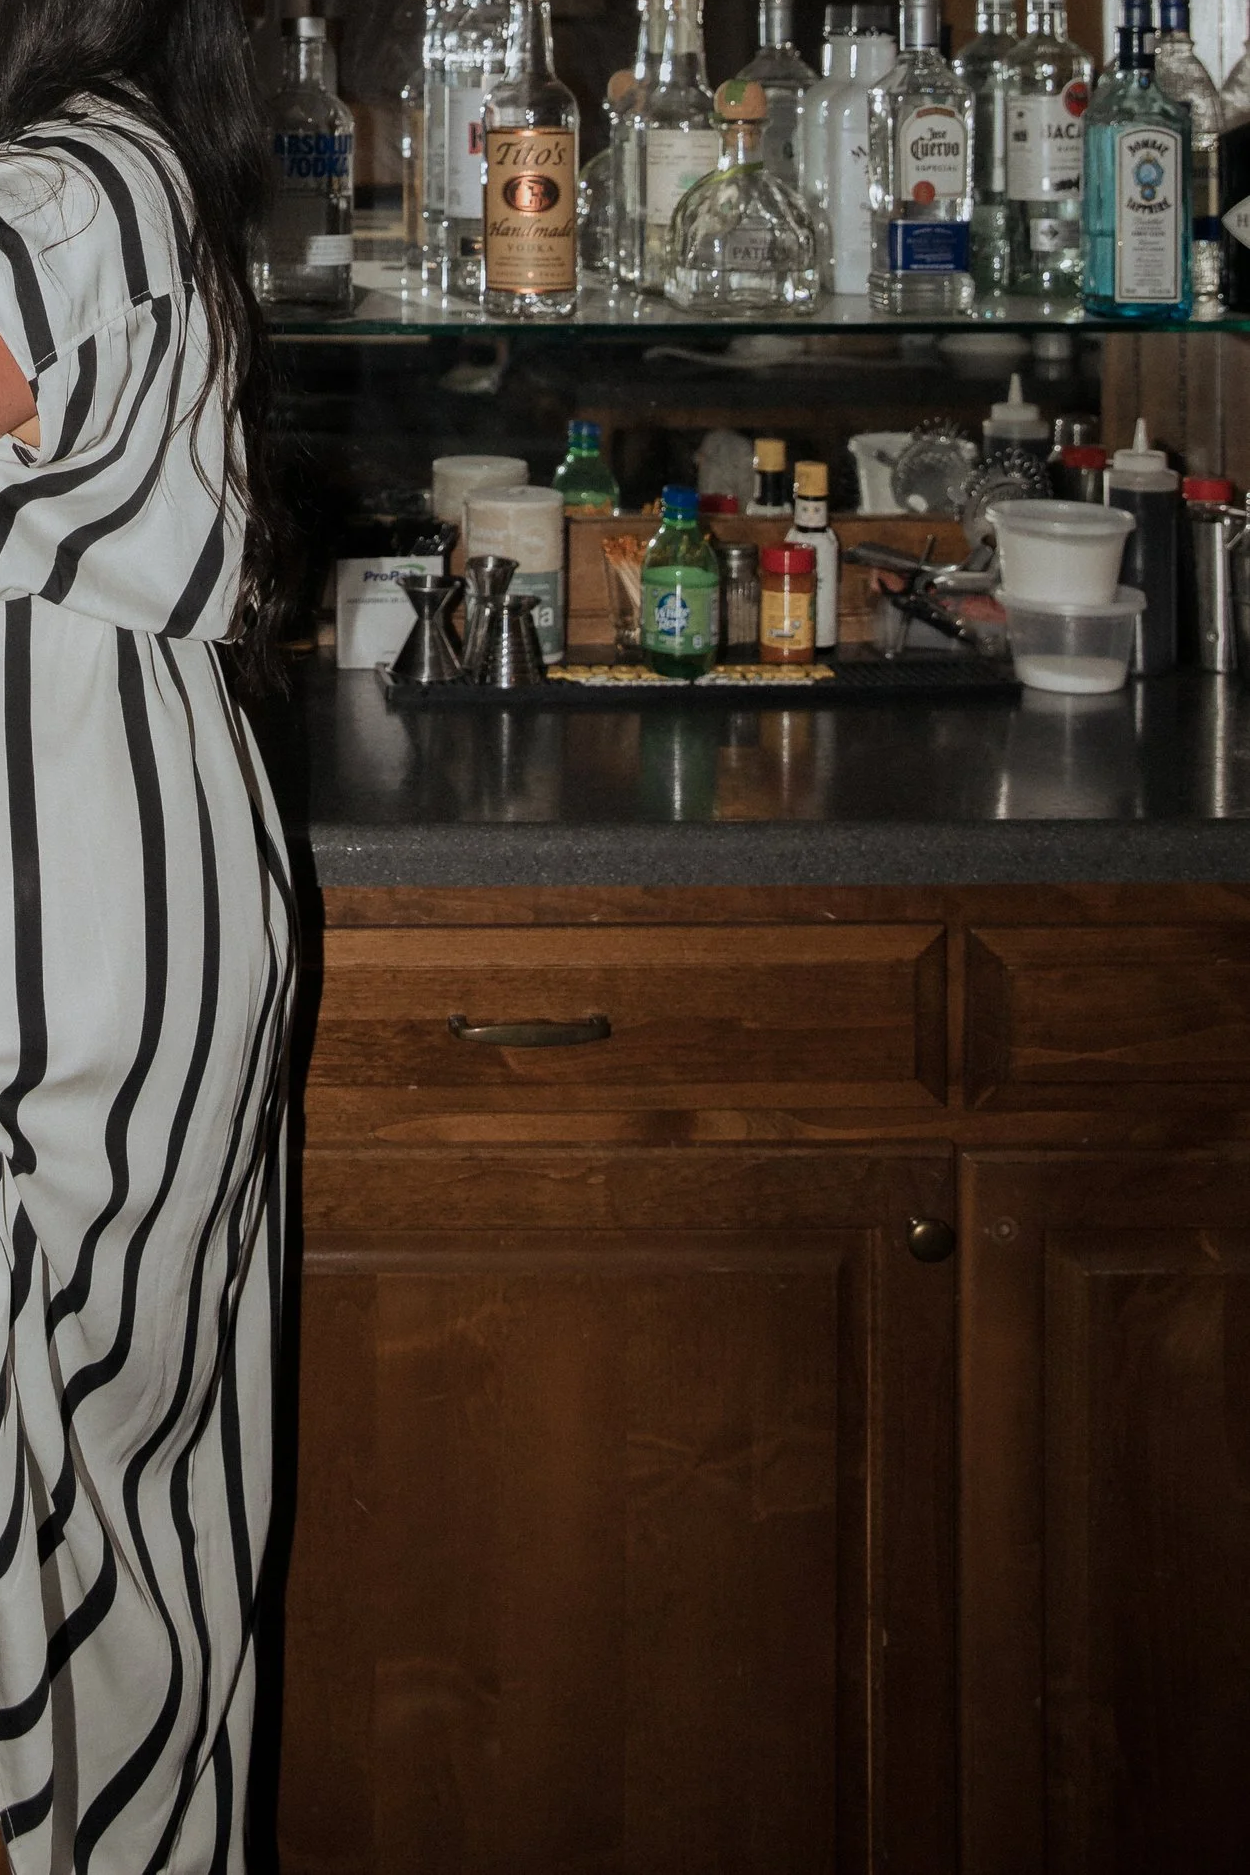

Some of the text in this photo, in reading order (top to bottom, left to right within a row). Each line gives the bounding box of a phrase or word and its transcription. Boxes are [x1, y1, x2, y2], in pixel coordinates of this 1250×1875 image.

[494, 140, 567, 166] Tito's
[911, 135, 960, 161] Cuervo
[1127, 137, 1171, 158] BOMBAY
[507, 243, 554, 253] VODKA
[363, 570, 419, 582] ProP
